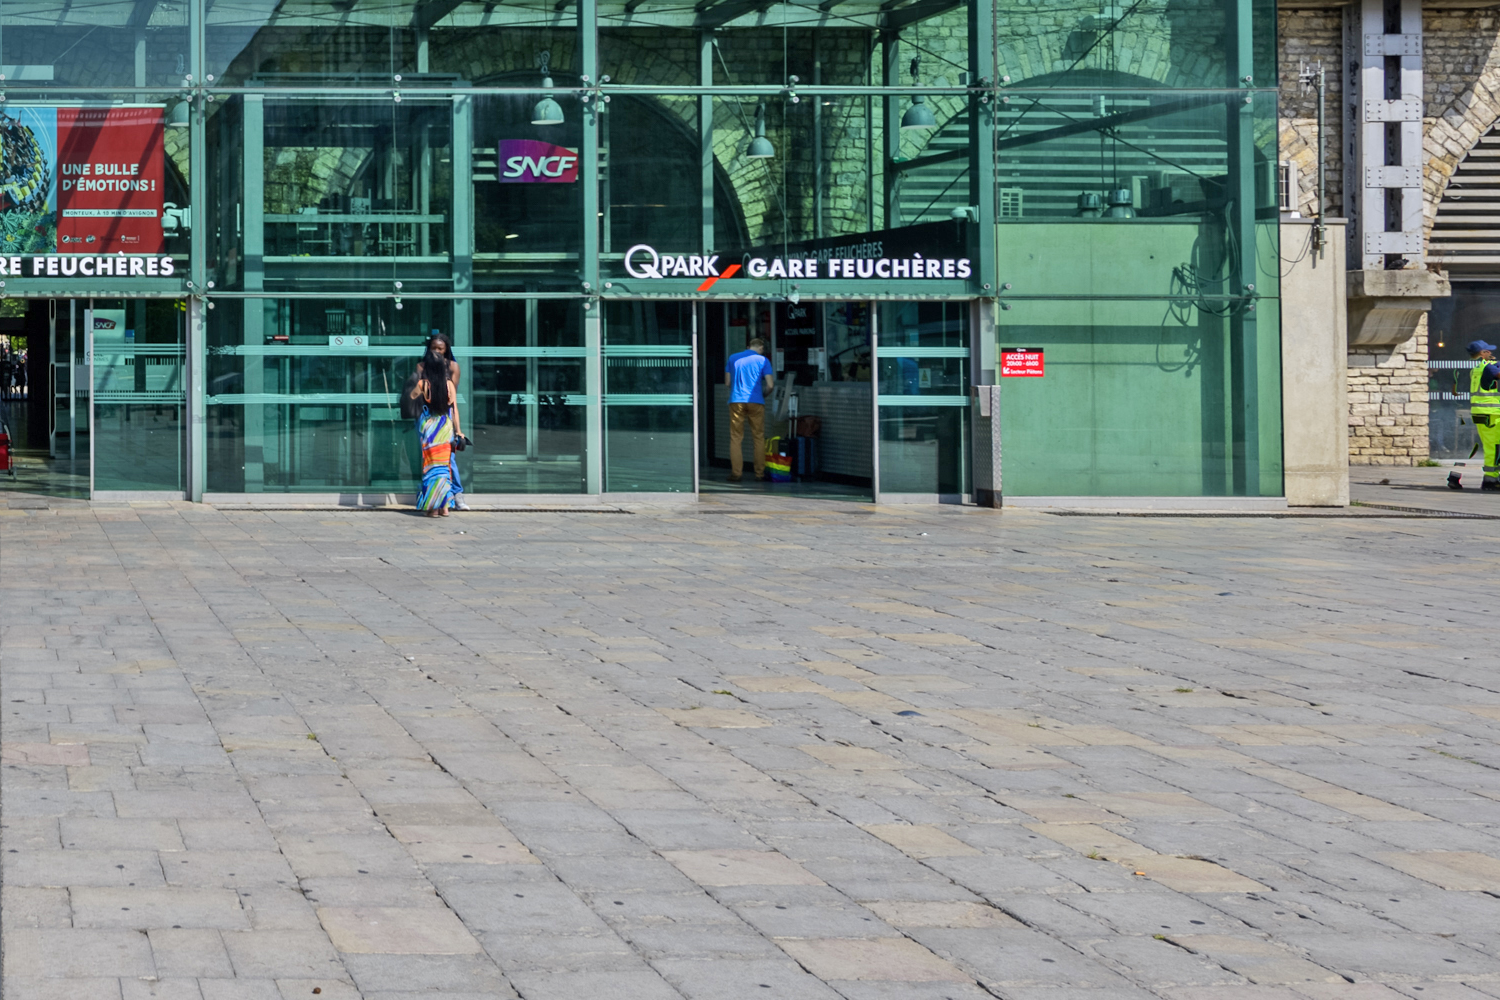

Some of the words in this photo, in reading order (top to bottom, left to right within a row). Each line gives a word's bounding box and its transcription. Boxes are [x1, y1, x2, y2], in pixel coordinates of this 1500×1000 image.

[62, 163, 91, 176] UNE
[95, 163, 139, 176] BULLE
[503, 156, 577, 178] SNCF
[835, 238, 883, 260] FEUCHÈRES
[33, 250, 175, 276] FEUCHÈRES
[748, 258, 818, 278] GARE
[828, 252, 972, 279] FEUCHÈRES
[94, 321, 115, 329] SNCF
